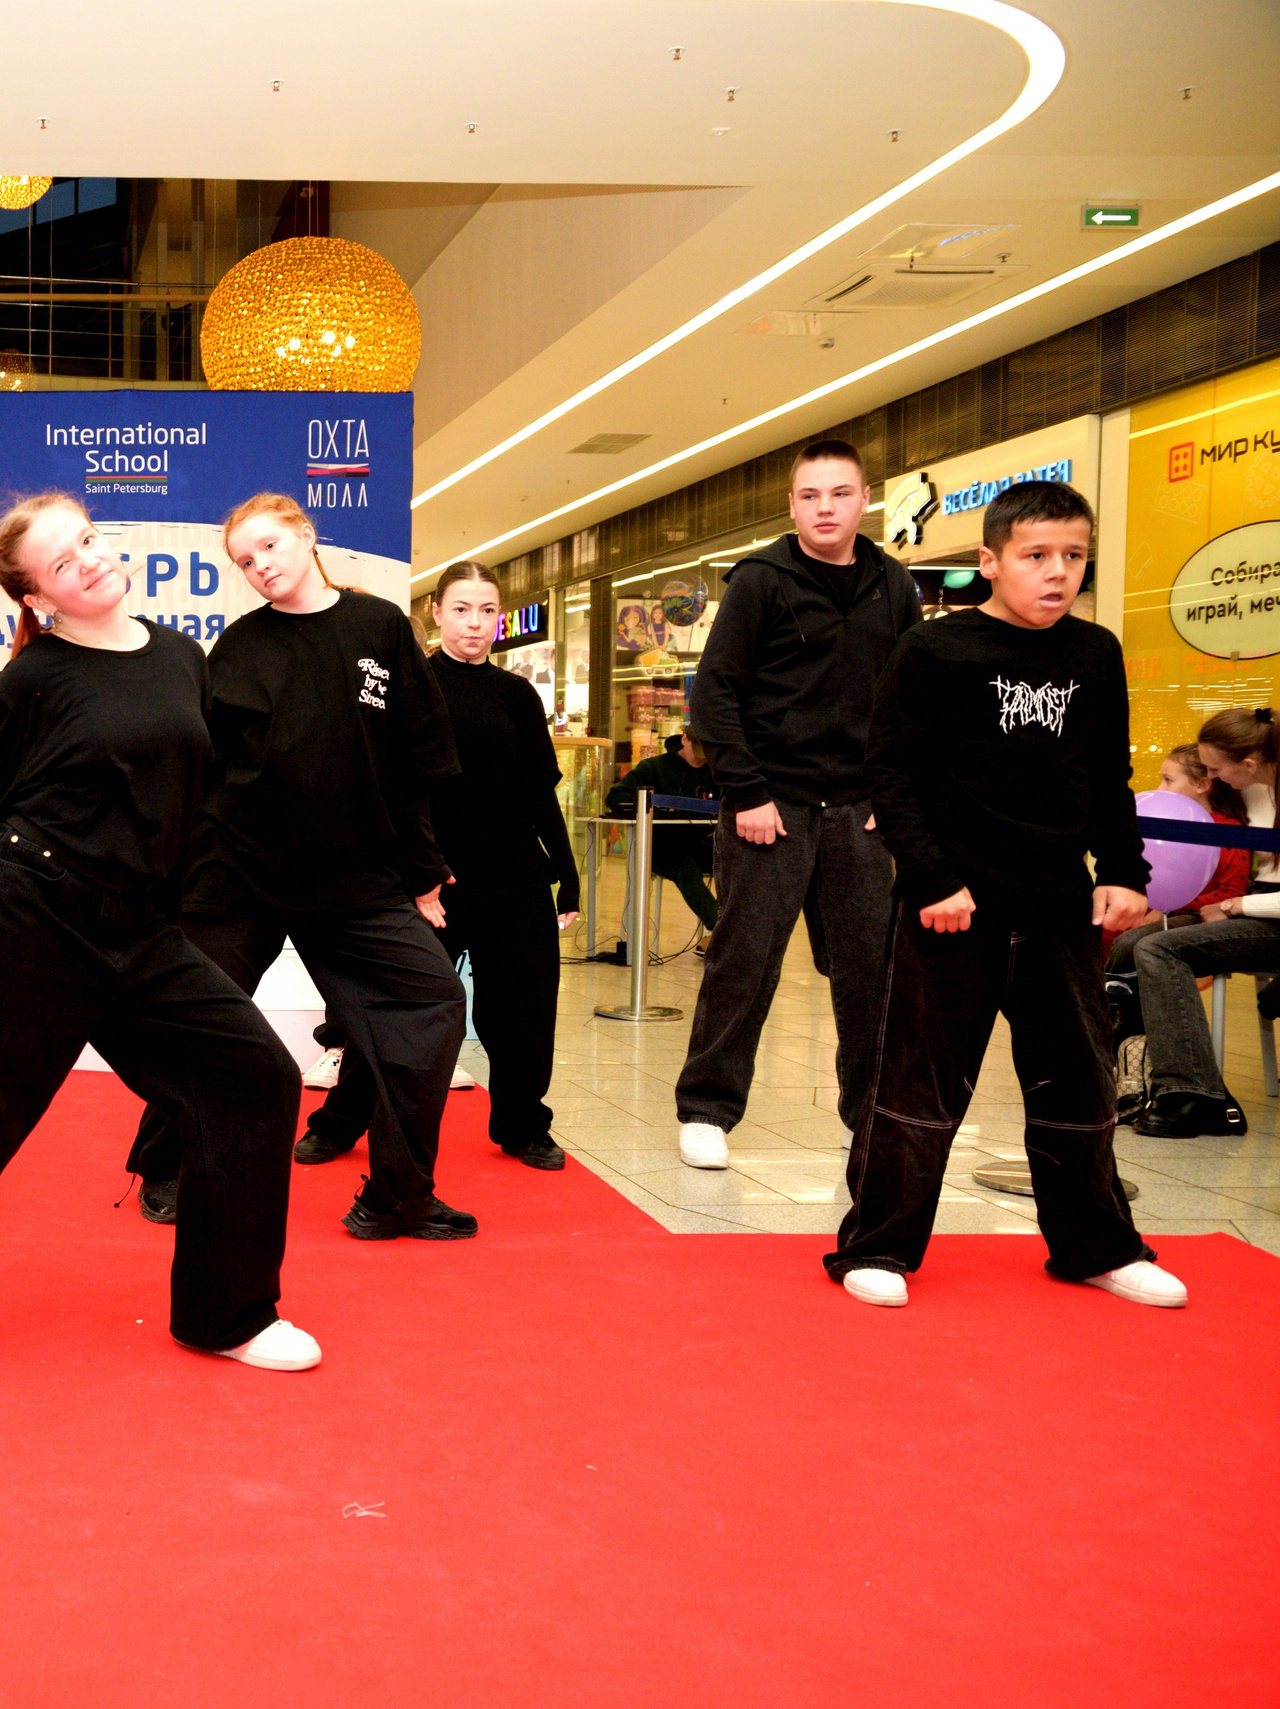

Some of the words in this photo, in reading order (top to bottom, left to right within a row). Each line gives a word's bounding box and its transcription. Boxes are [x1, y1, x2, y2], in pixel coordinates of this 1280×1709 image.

[46, 422, 207, 446] International
[308, 419, 370, 459] ОХТА
[85, 450, 168, 473] School
[85, 483, 111, 494] Saint
[113, 484, 168, 495] Petersburg
[942, 475, 1012, 515] ВЕСЁЛАЯ
[1187, 594, 1243, 624] играй,
[364, 673, 378, 691] by
